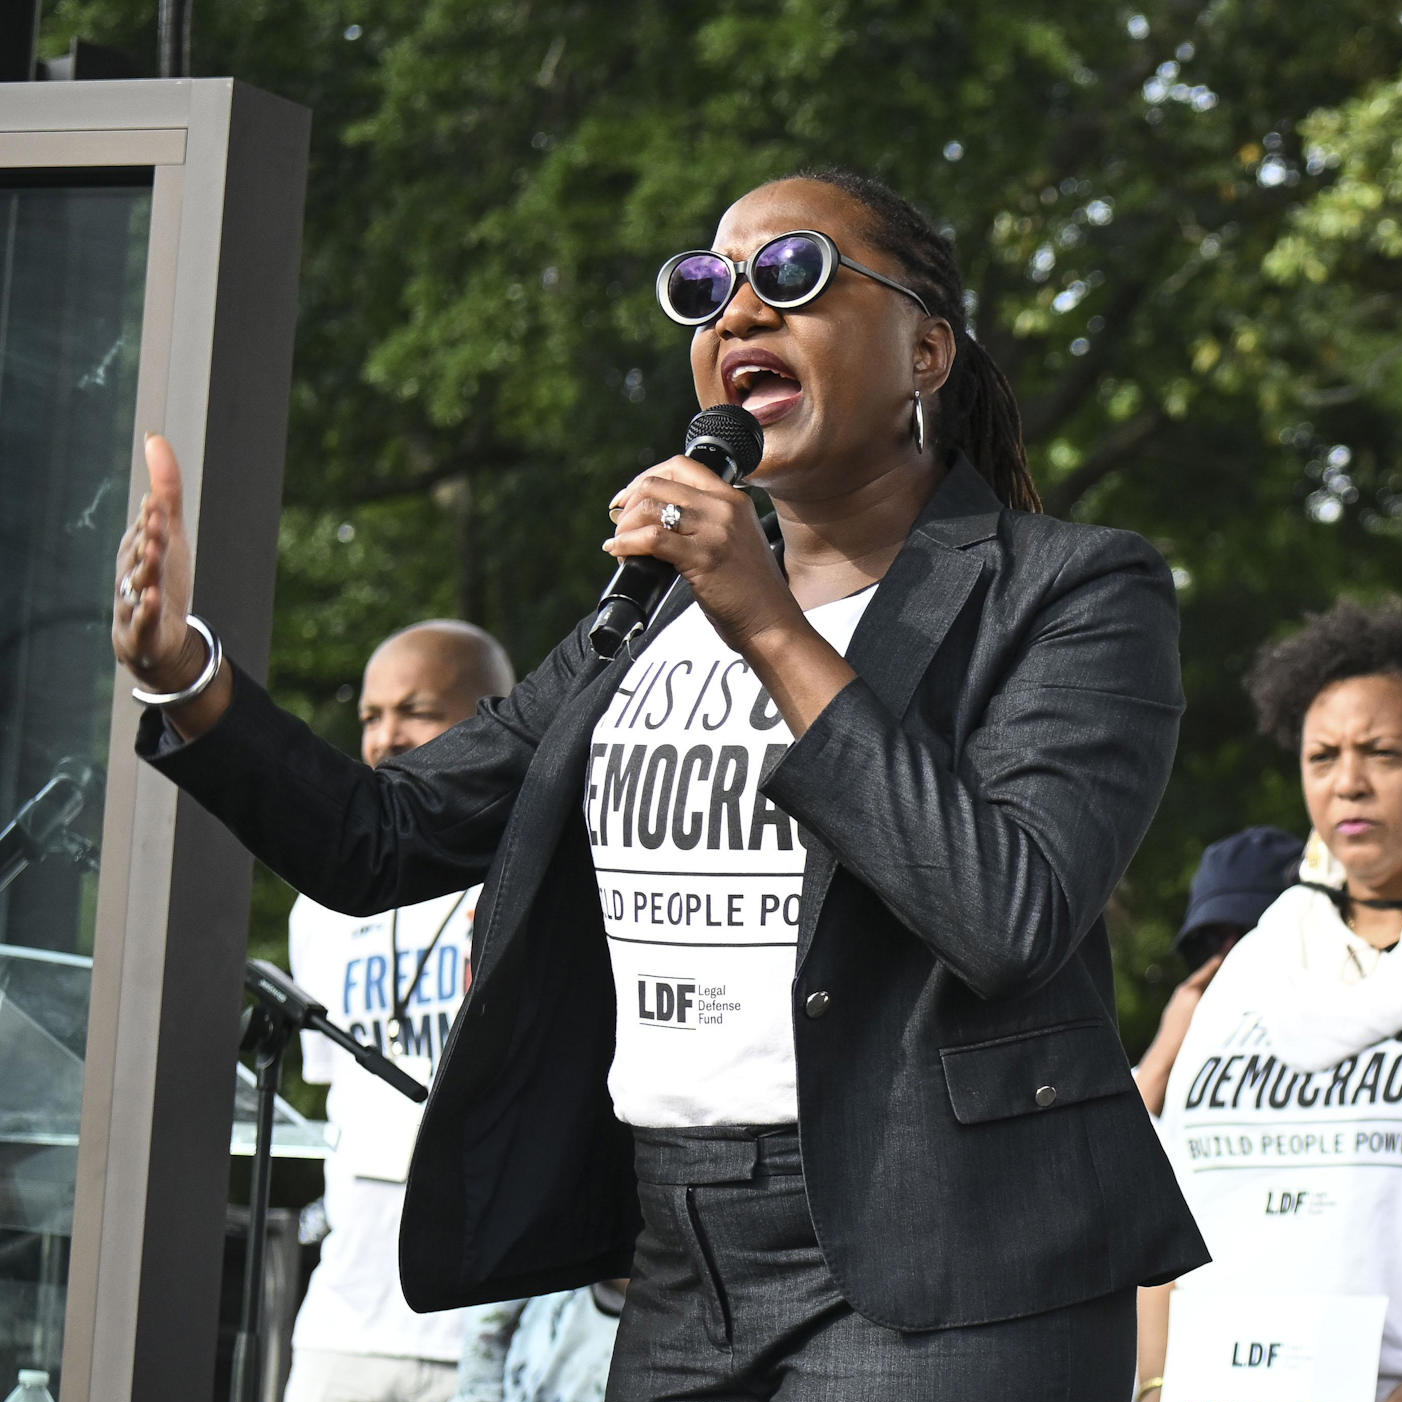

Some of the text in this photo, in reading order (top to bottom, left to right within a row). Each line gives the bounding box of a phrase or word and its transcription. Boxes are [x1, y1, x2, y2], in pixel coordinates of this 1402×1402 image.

[601, 660, 692, 730] HIS
[684, 659, 749, 731] IS
[590, 744, 808, 850] EMOCRA
[634, 890, 744, 926] PEOPLE
[343, 945, 458, 1014] FREED
[638, 980, 726, 1023] LDF Legal
[698, 999, 741, 1011] Defense
[698, 1012, 723, 1024] Fund
[1188, 1134, 1253, 1159] BUILD
[1261, 1133, 1345, 1156] PEOPLE
[1265, 1191, 1306, 1215] LDF
[1232, 1342, 1282, 1370] LDF
